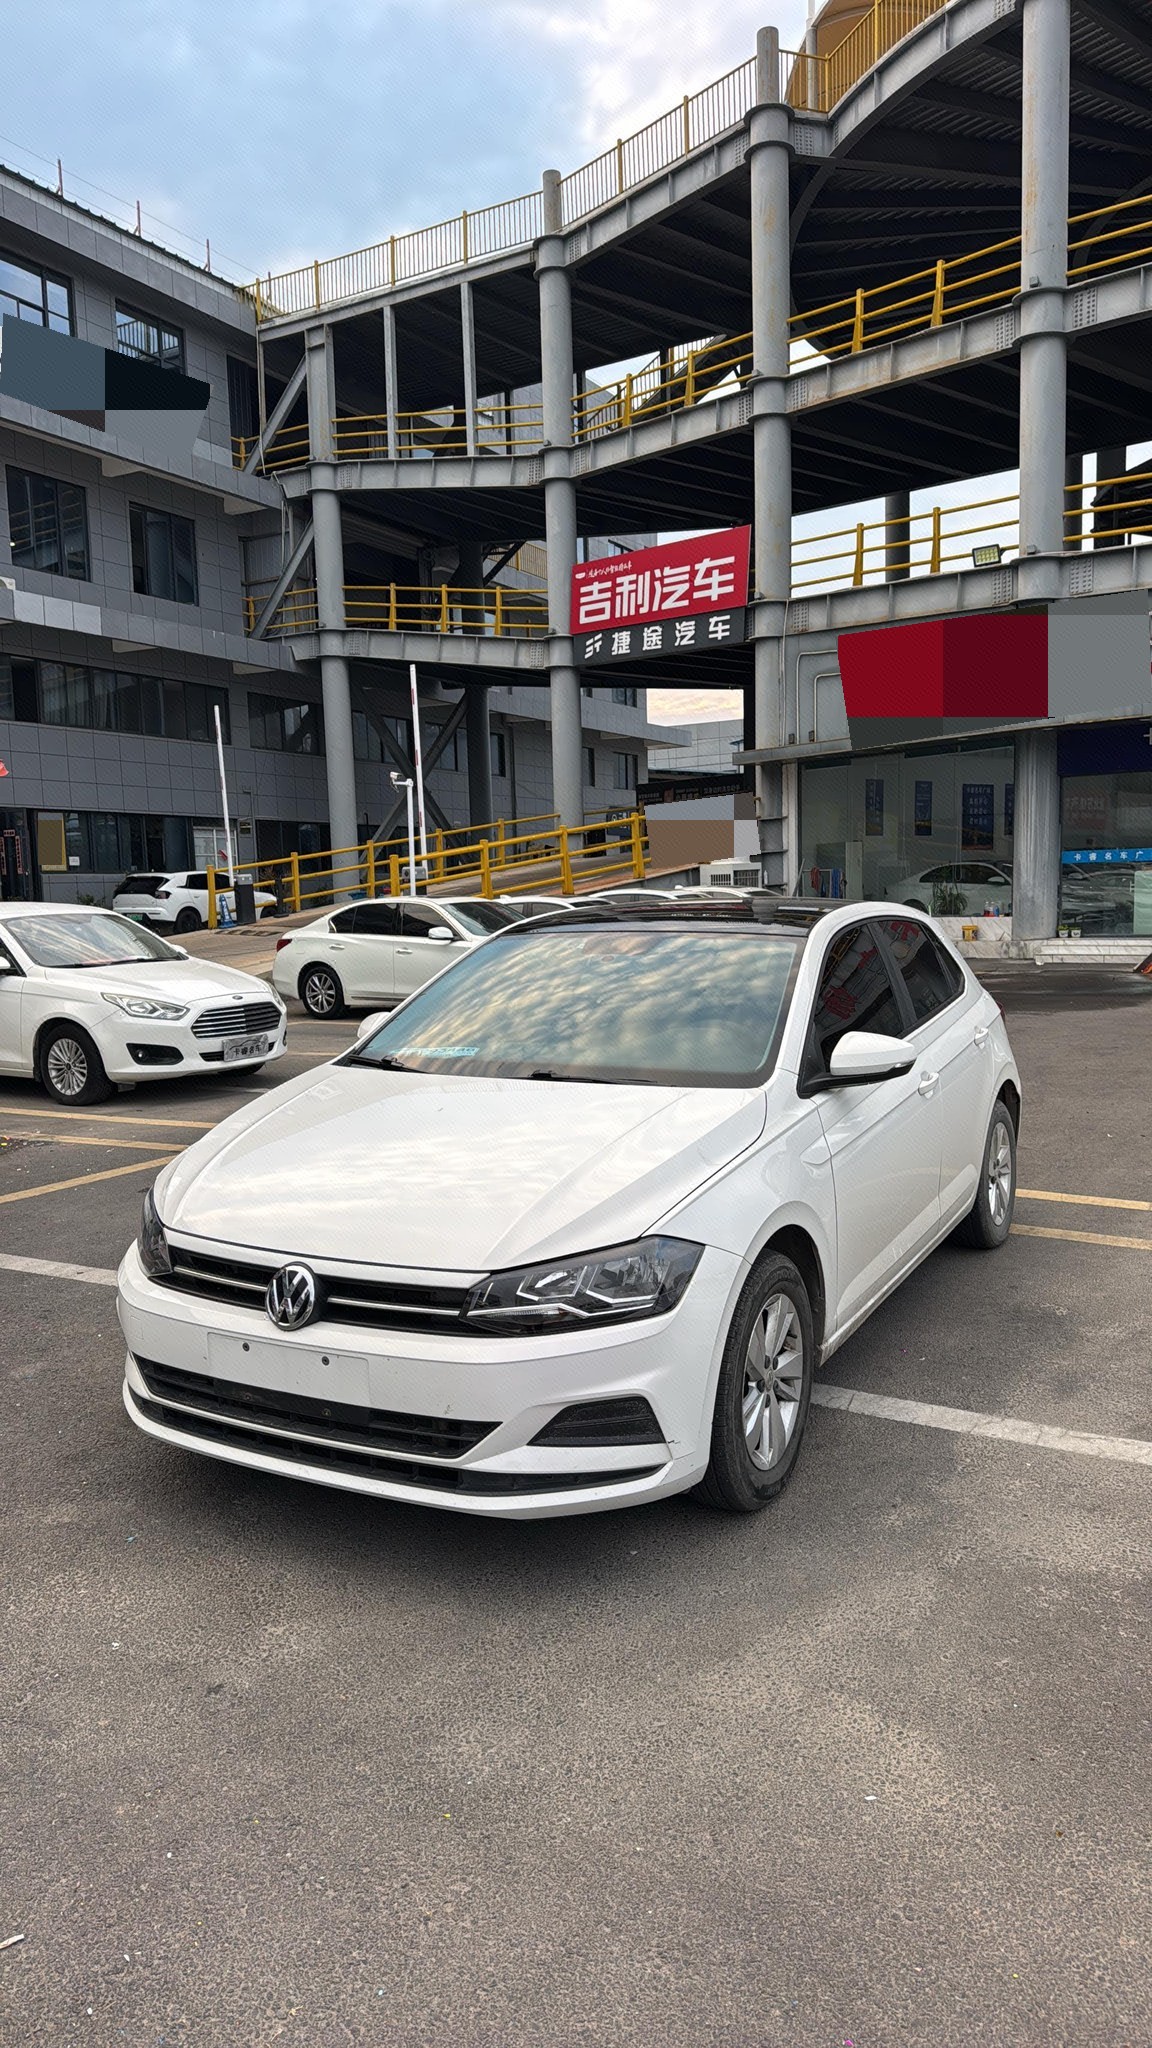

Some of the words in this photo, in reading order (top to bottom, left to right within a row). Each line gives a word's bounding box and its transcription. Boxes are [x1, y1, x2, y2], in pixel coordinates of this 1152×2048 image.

[579, 556, 735, 625] 吉利汽车
[611, 615, 731, 656] 捷途汽车
